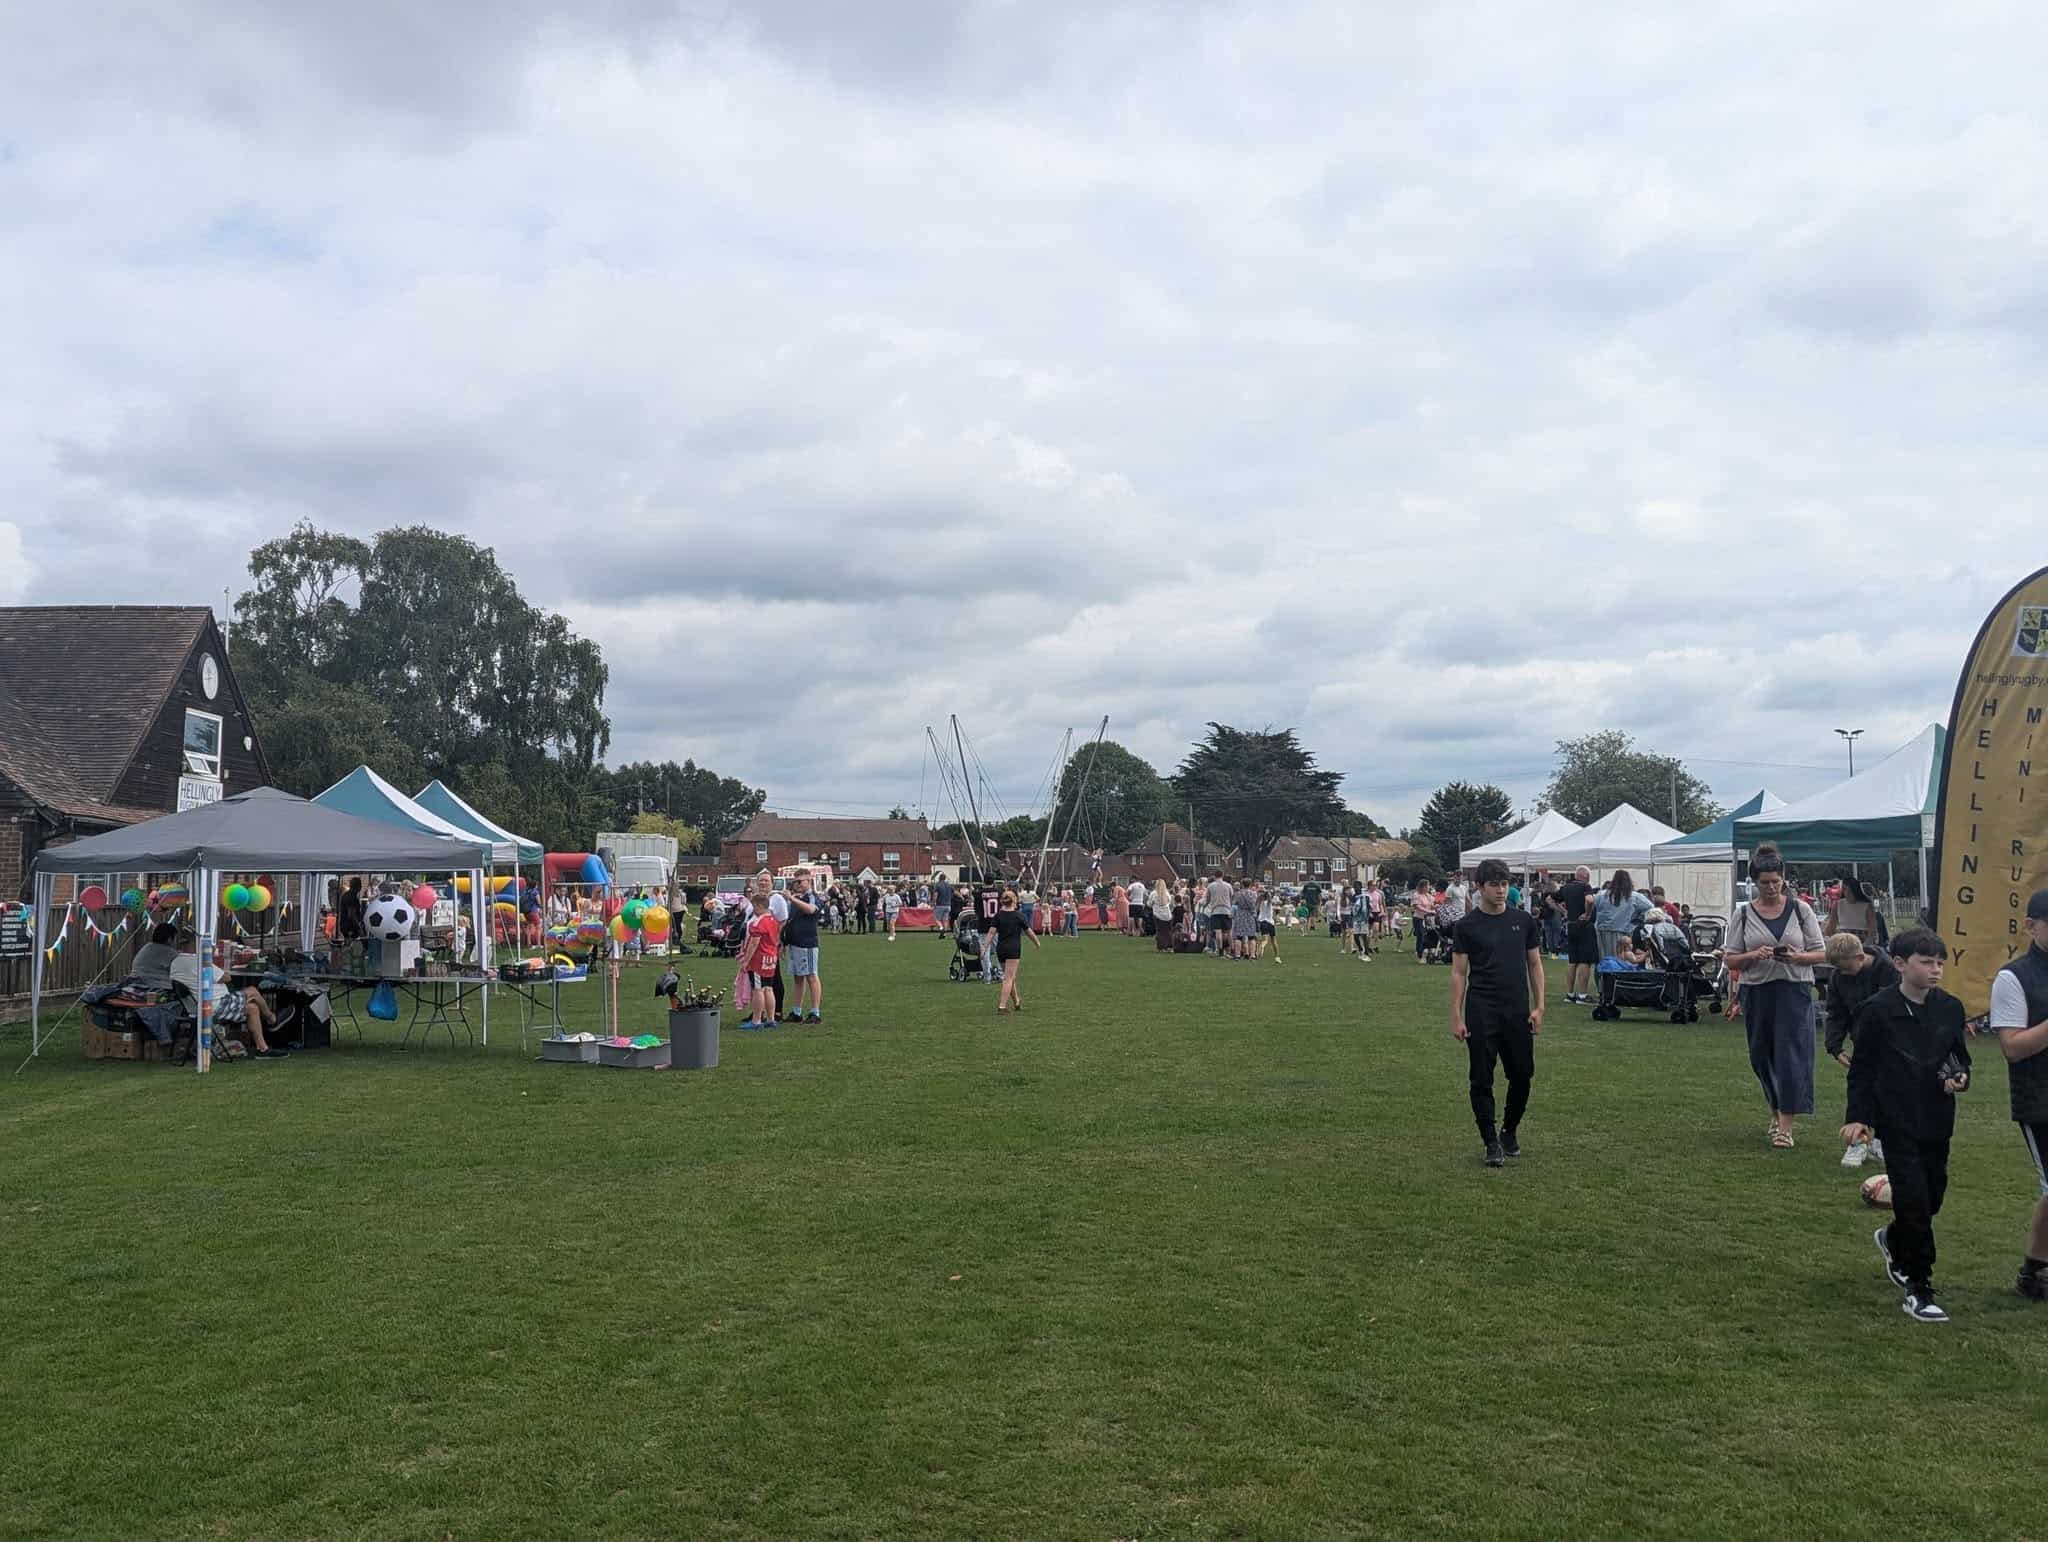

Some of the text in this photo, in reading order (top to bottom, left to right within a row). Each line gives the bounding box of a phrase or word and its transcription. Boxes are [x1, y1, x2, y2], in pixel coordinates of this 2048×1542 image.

[180, 781, 221, 801] HELLINGLY
[1951, 698, 1998, 967] HELLINGLY
[2006, 707, 2042, 960] MINI RUGBY
[982, 898, 998, 918] 10
